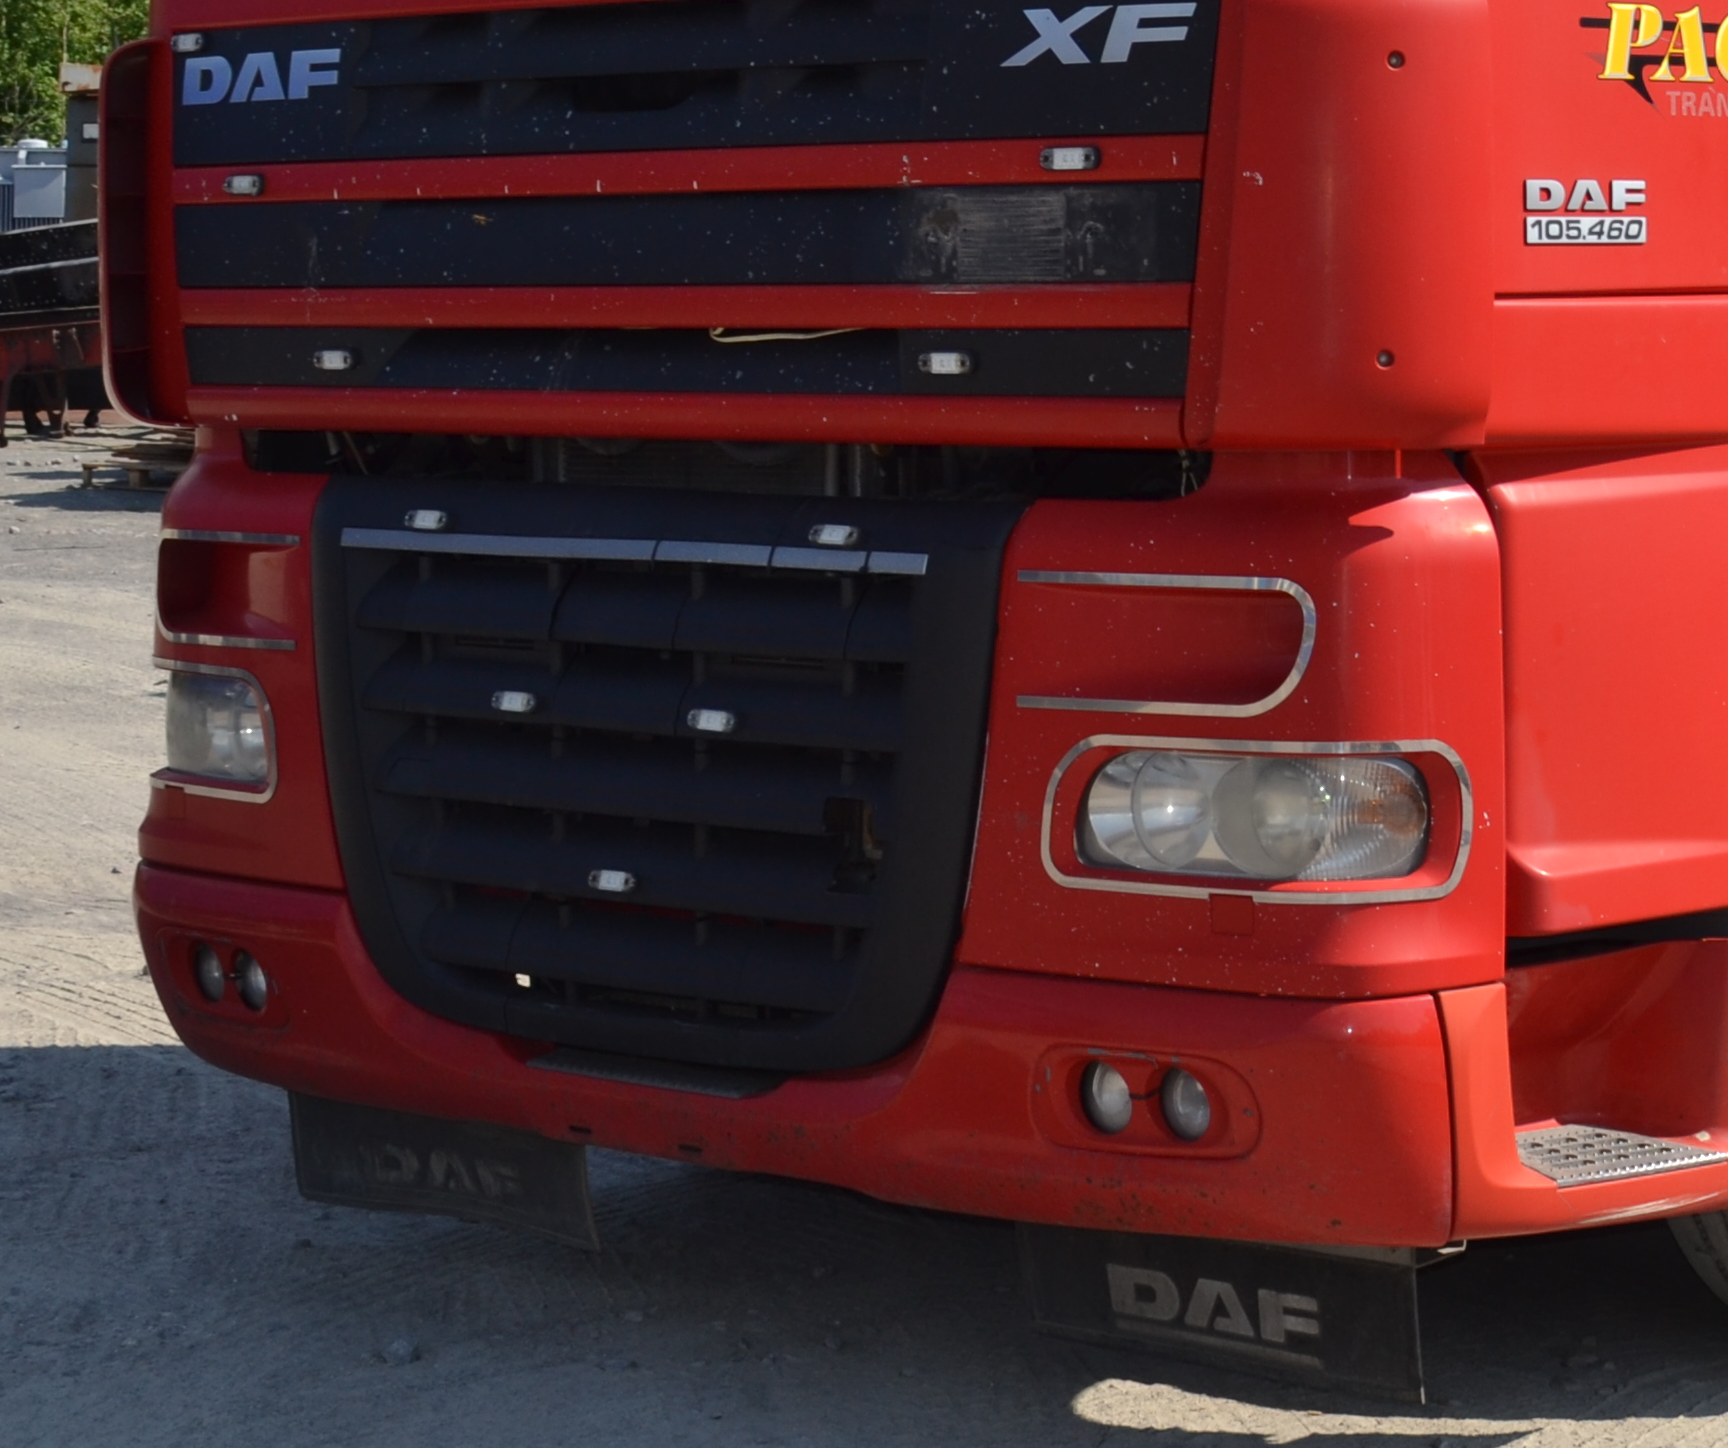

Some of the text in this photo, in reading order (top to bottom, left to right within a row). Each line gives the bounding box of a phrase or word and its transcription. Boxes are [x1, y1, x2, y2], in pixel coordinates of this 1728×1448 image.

[1000, 2, 1197, 67] XF
[182, 48, 342, 106] DAF
[1524, 179, 1647, 211] DAF
[1530, 219, 1643, 241] 105.460
[360, 1143, 523, 1198] DAF
[1106, 1263, 1321, 1343] DAF
